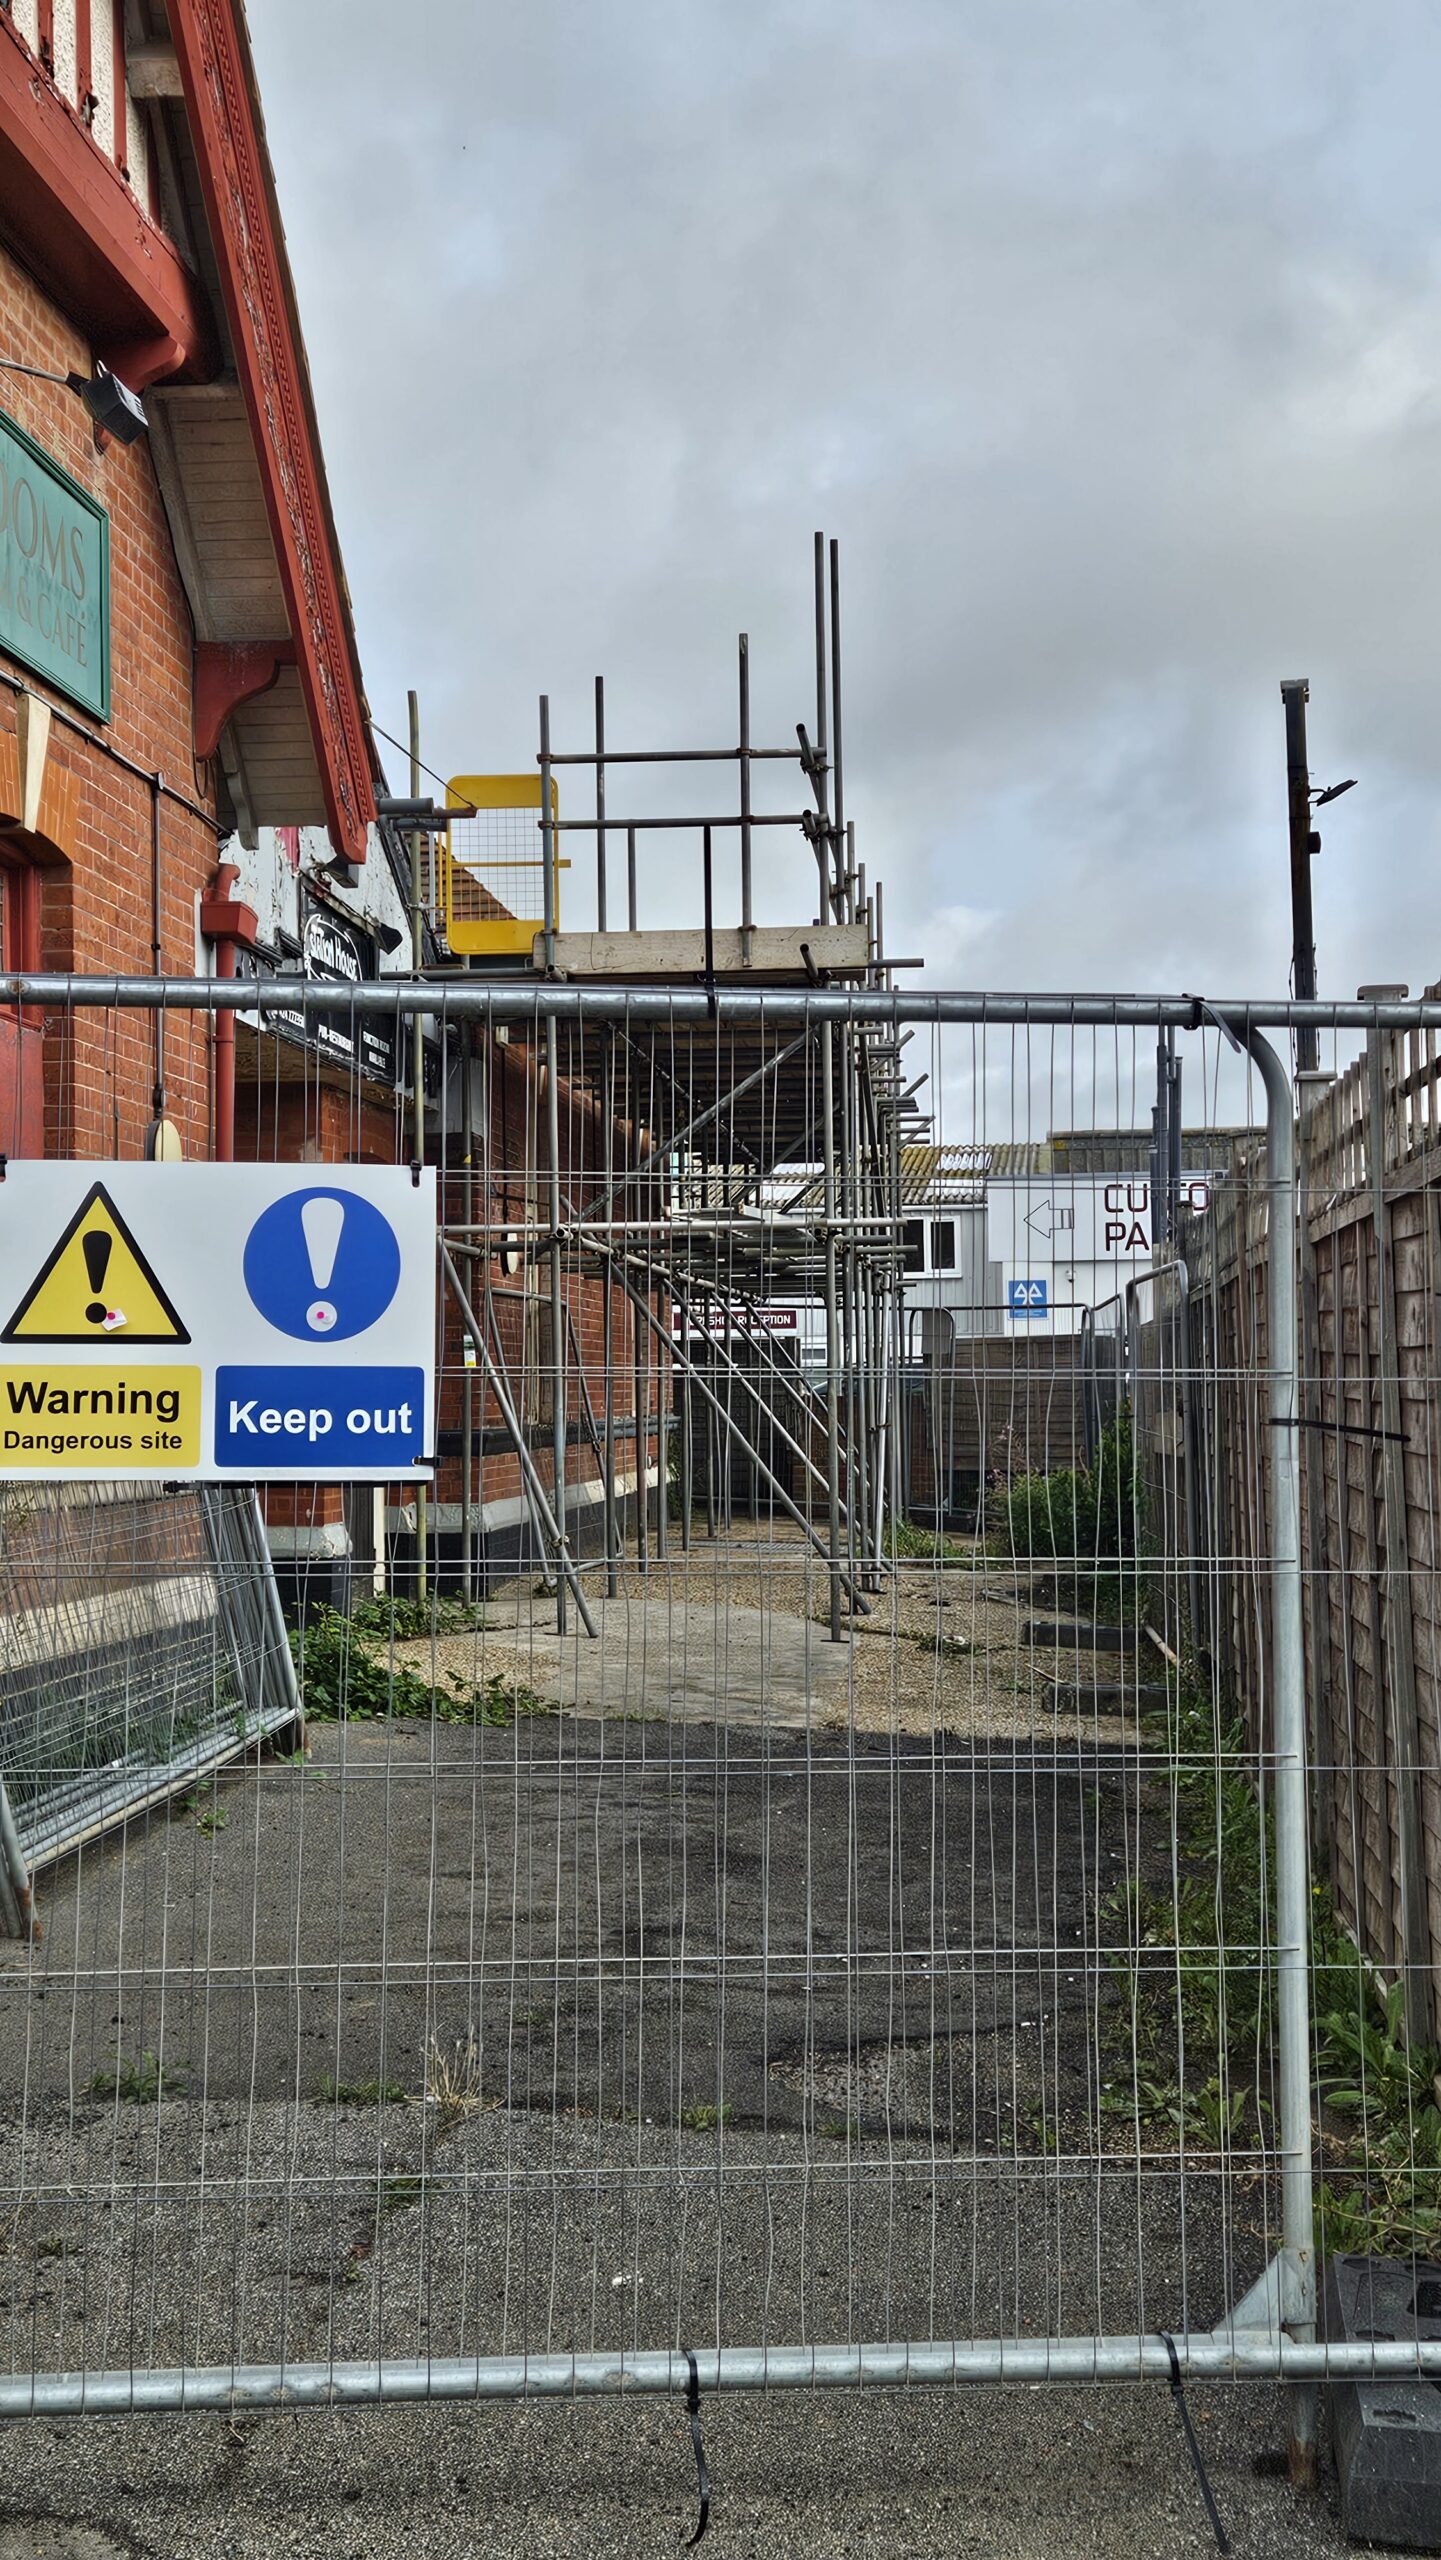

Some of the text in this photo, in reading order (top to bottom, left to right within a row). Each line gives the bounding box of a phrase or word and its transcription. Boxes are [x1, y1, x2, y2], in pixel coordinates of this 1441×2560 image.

[17, 576, 32, 626] &
[38, 594, 88, 667] CAFÉ
[1104, 1182, 1210, 1213] CUO
[737, 1314, 791, 1326] RCPTION
[6, 1382, 181, 1423] Warning
[229, 1401, 412, 1442] Keep out
[4, 1431, 183, 1454] Dangerous site
